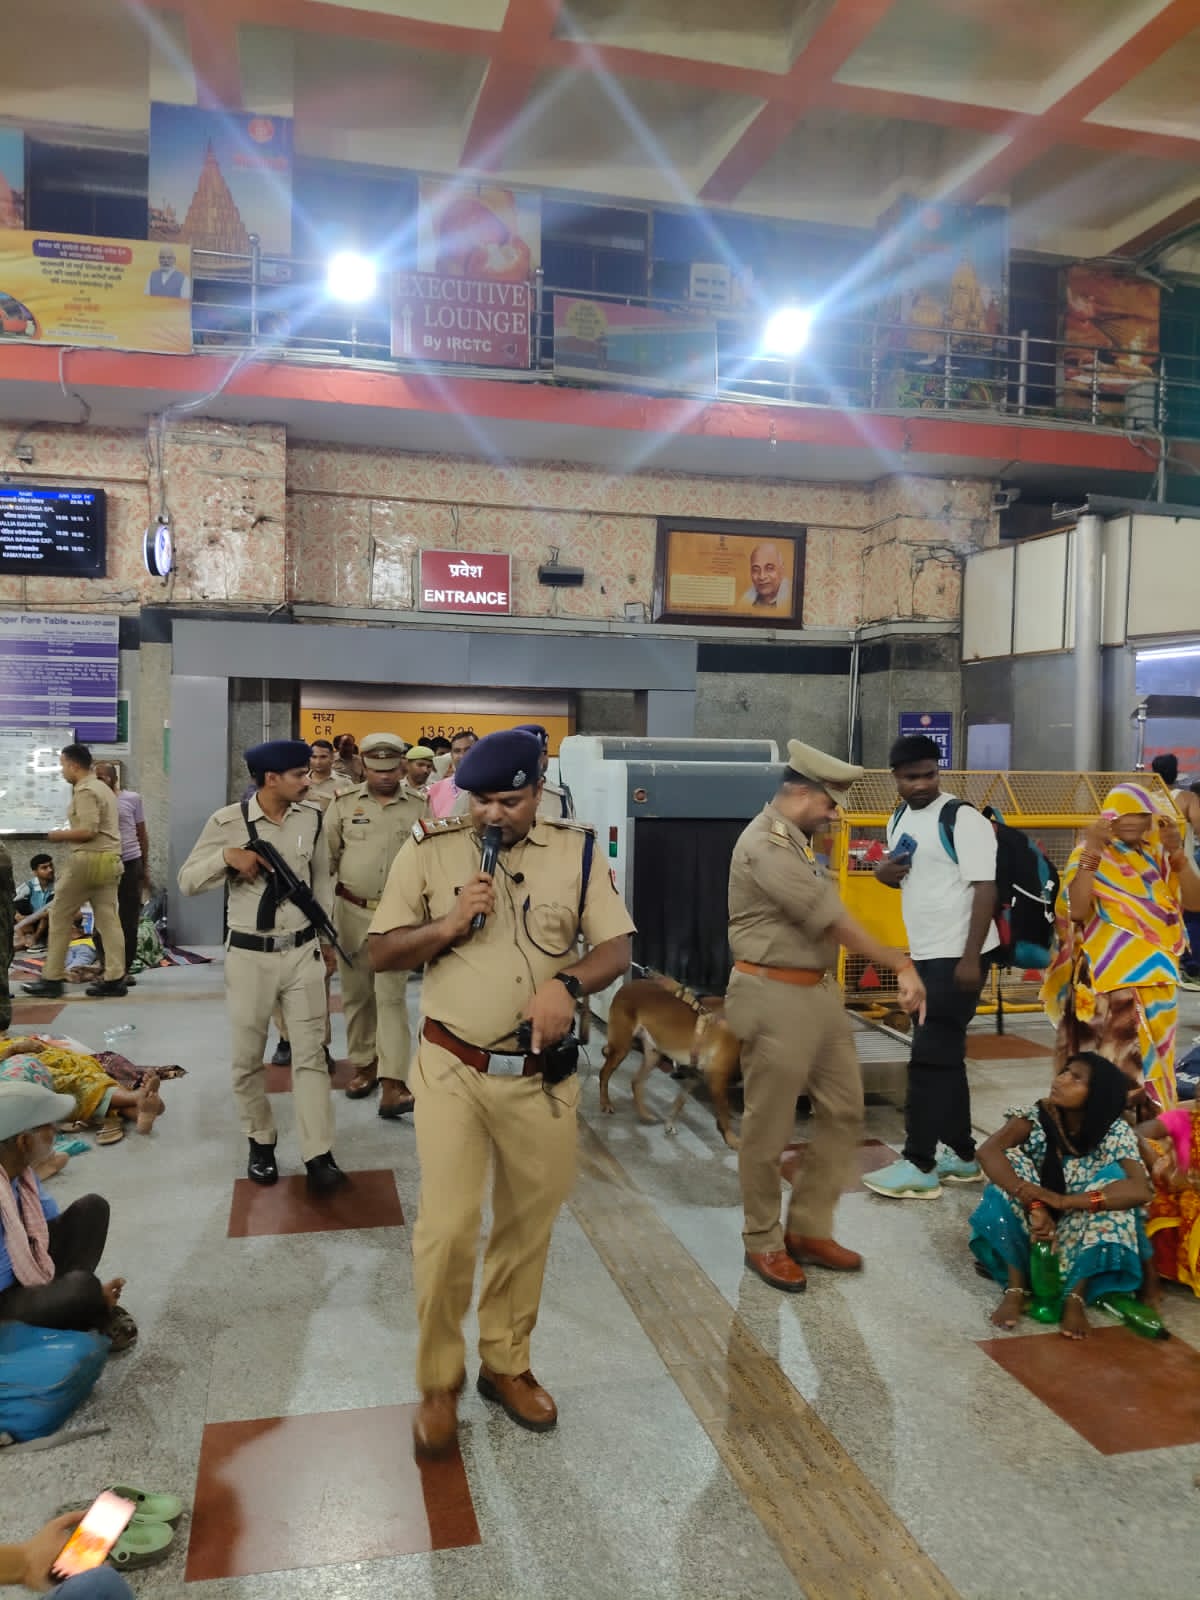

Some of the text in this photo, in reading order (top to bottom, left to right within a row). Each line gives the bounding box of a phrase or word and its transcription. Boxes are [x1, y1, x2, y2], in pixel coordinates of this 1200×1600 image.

[398, 274, 526, 307] EXECUTIVE
[424, 304, 526, 335] LOUNGE
[423, 336, 492, 353] By IRCTC
[448, 559, 483, 578] प्रवेश
[424, 589, 507, 605] ENTRANCE
[44, 617, 68, 625] Table
[312, 712, 335, 723] मध्य
